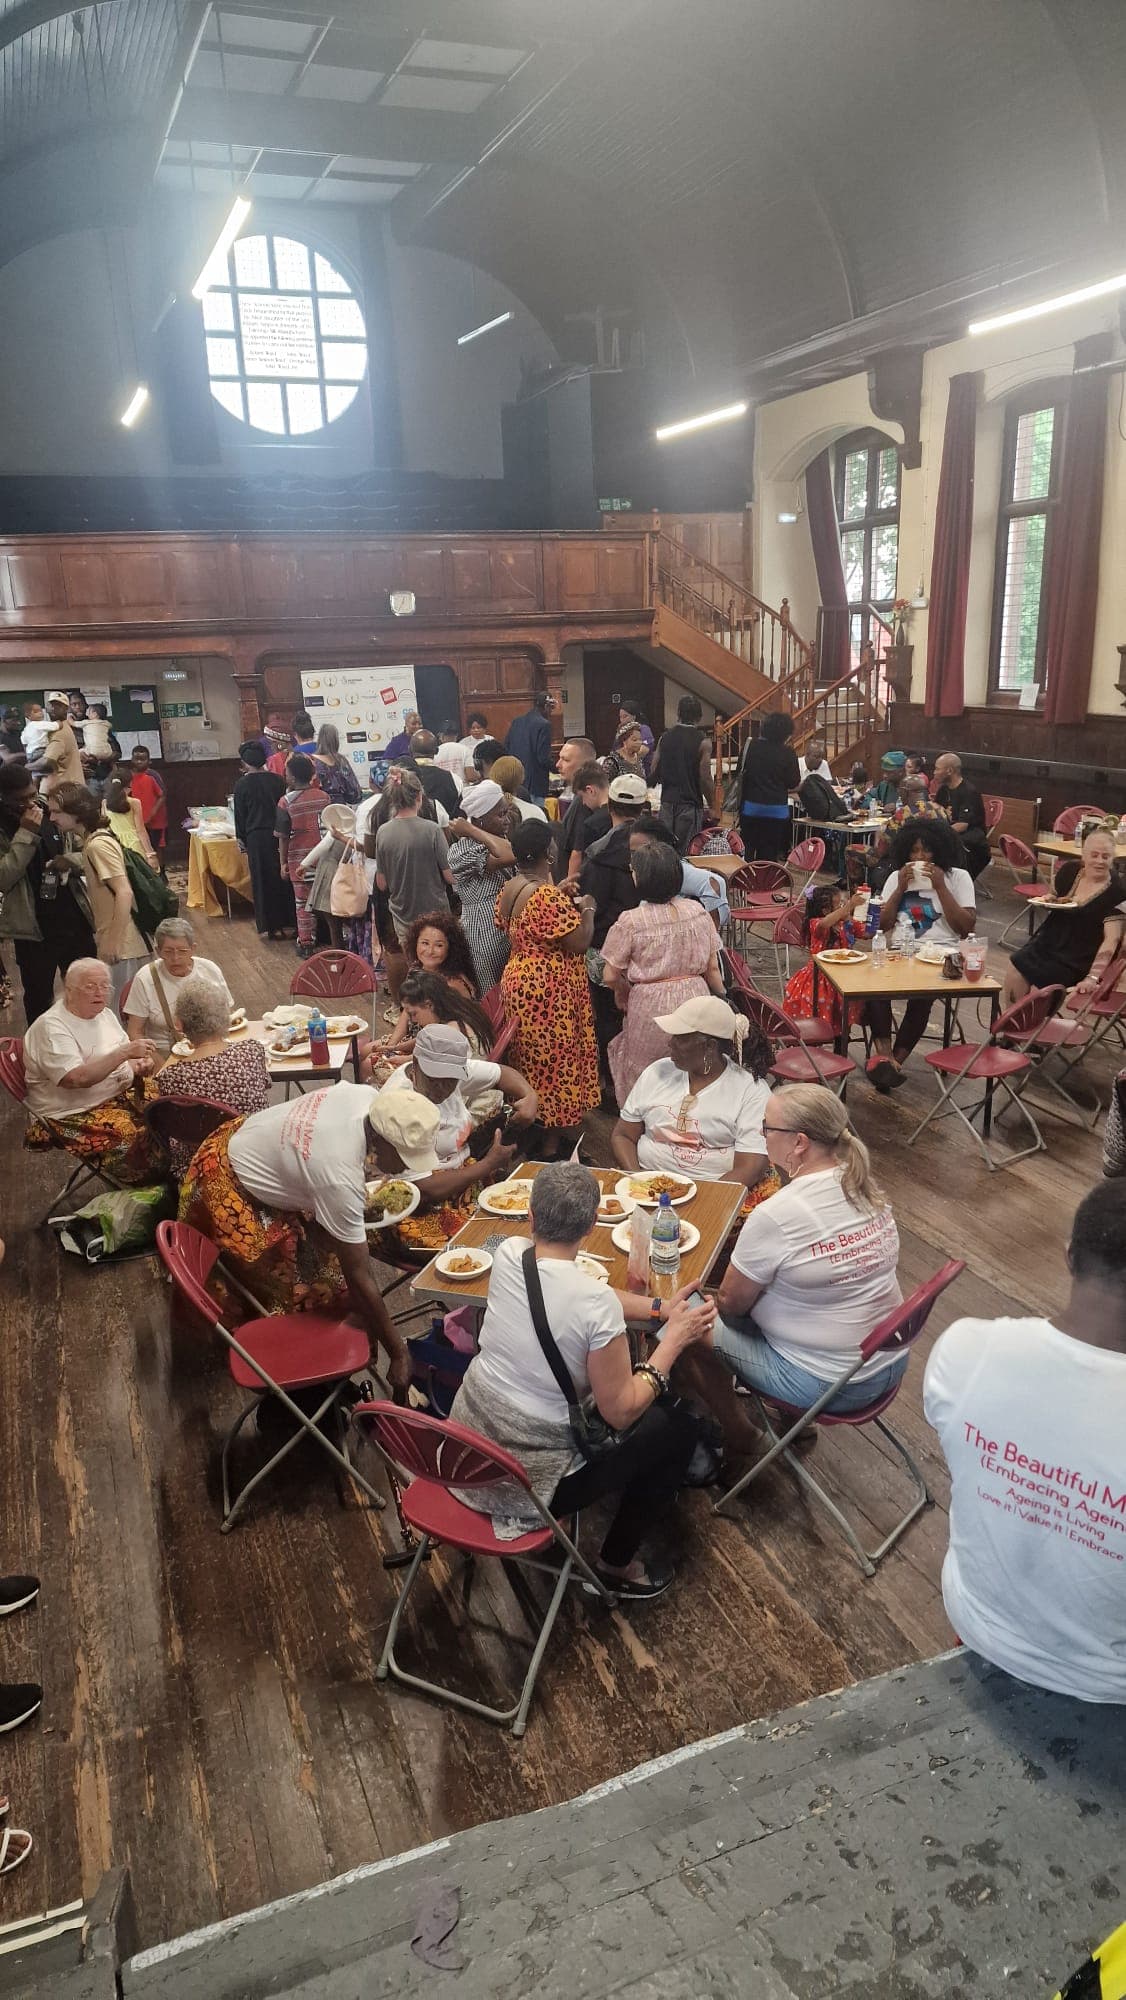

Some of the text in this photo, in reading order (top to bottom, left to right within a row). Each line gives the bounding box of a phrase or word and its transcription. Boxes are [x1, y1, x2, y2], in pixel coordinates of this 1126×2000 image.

[809, 1241, 836, 1257] The
[964, 1421, 999, 1454] The
[1004, 1441, 1098, 1499] Beautiful
[980, 1454, 1126, 1533] (Embracing Agein
[977, 1486, 1001, 1507] Love
[1003, 1502, 1012, 1513] it
[1018, 1508, 1052, 1528] Value
[1054, 1523, 1063, 1534] it
[1068, 1529, 1124, 1561] Embrace
[1005, 1487, 1105, 1541] Ageing is Living
